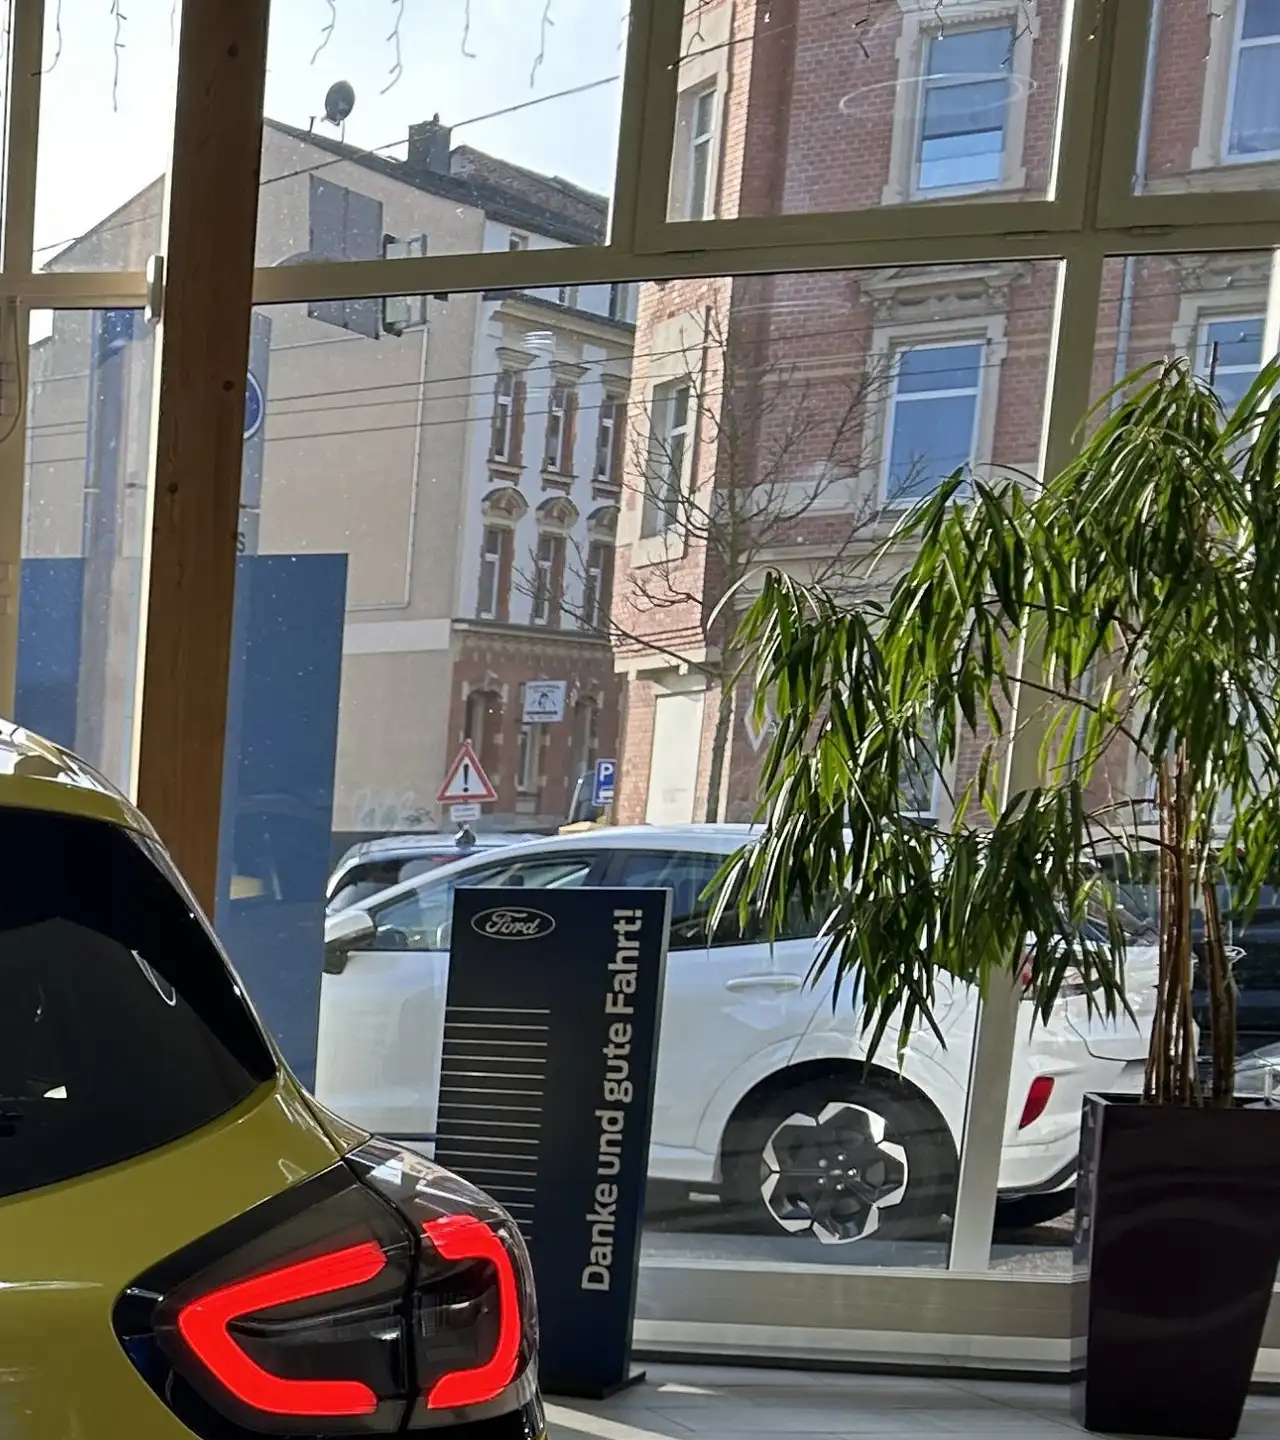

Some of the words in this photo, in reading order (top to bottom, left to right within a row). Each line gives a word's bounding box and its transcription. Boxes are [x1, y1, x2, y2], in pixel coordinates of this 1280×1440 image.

[600, 763, 614, 782] P
[485, 910, 540, 936] Ford
[604, 908, 644, 1014] Fahrt!
[602, 1022, 635, 1105] gute
[594, 1109, 625, 1177] und
[581, 1183, 619, 1292] Danke
